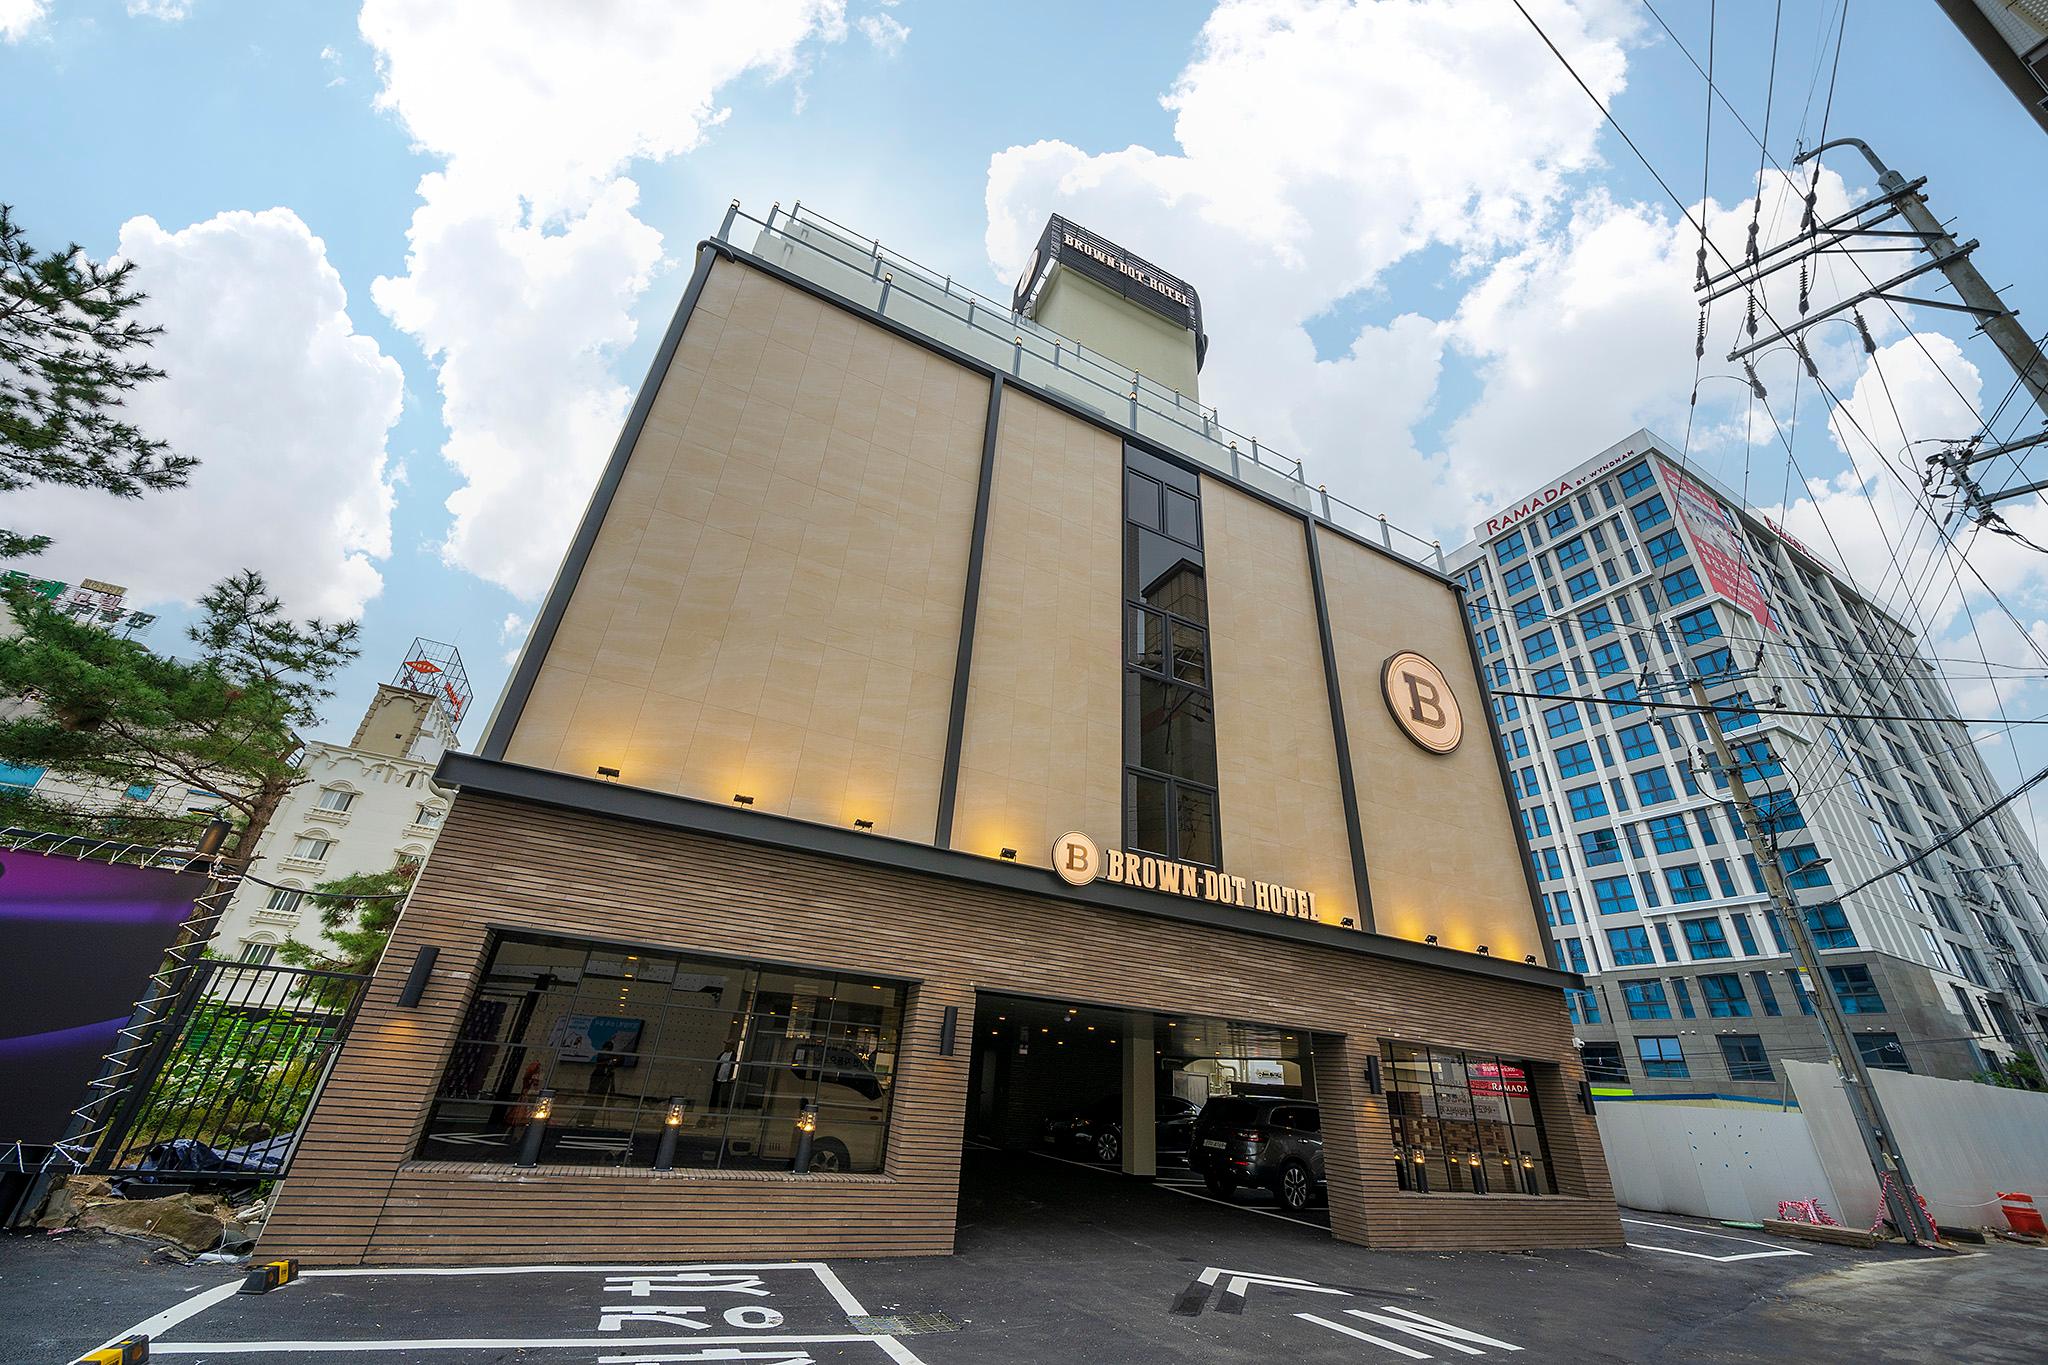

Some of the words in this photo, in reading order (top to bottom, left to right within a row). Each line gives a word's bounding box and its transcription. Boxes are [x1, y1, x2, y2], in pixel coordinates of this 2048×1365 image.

[1149, 276, 1190, 307] HOTEL
[1486, 481, 1574, 536] RAMADA
[1575, 476, 1587, 487] BY
[1589, 450, 1635, 478] WYNDHAM
[411, 662, 436, 672] HOTEL
[1401, 670, 1446, 730] B
[1065, 842, 1089, 873] B
[1252, 880, 1320, 922] HOTEL
[1491, 1082, 1529, 1094] RAMADA
